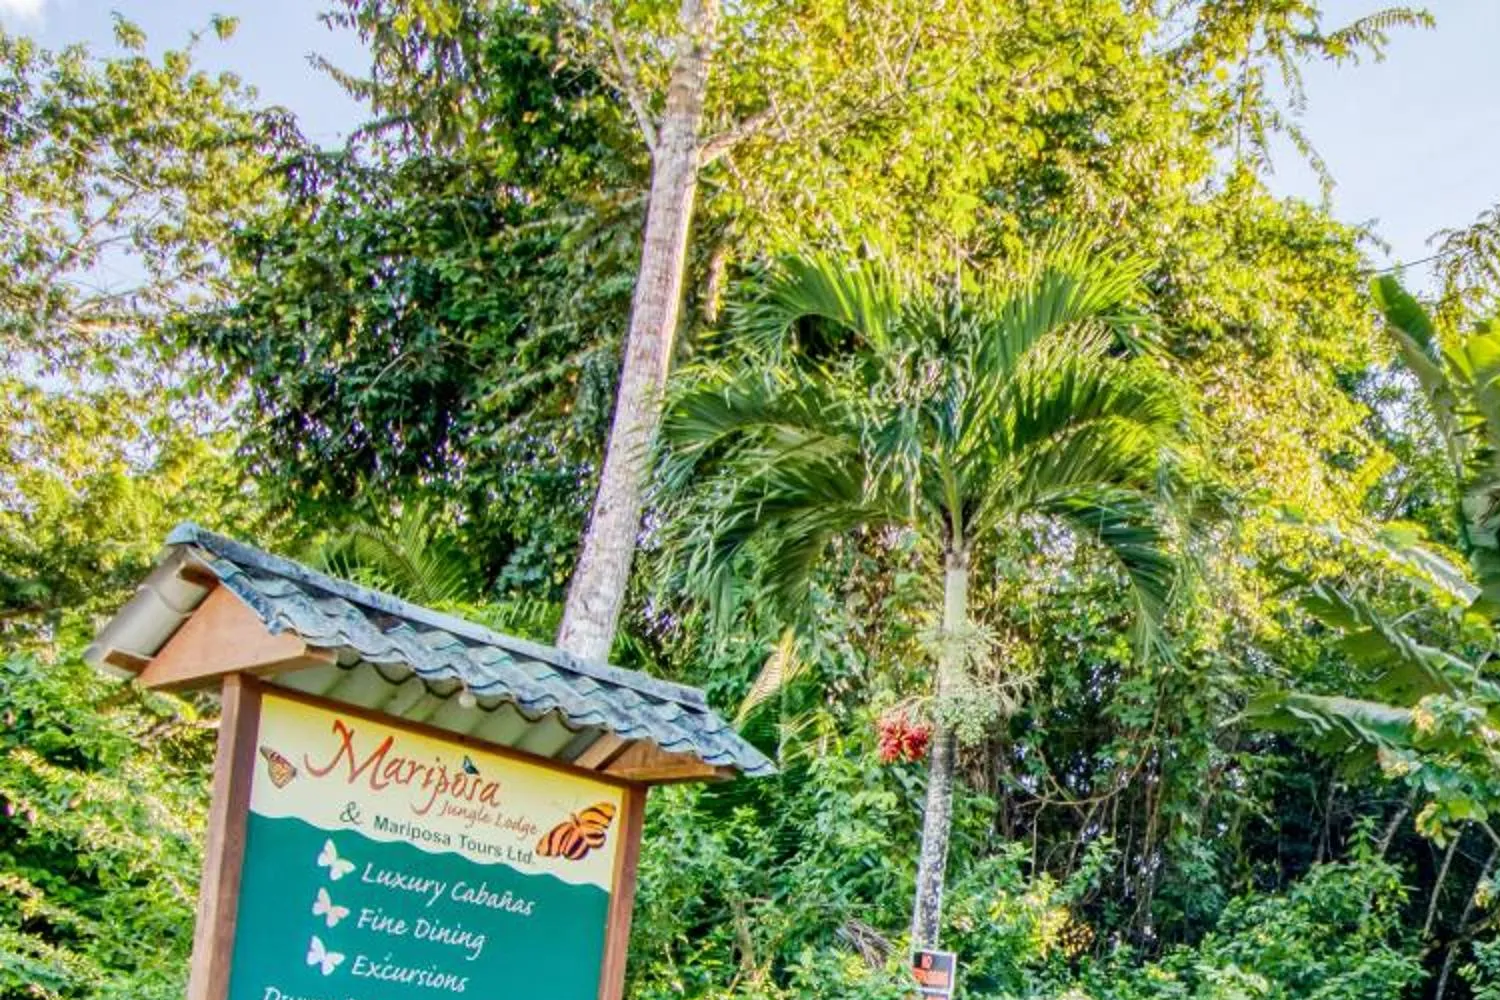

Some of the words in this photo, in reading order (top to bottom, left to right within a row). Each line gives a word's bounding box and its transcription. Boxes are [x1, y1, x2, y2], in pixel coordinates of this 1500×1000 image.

[304, 719, 501, 815] Mariposa
[339, 801, 364, 825] &
[373, 815, 451, 845] Mariposa
[458, 834, 502, 857] Tours
[507, 845, 536, 864] Ltd.
[440, 799, 492, 830] Jungle
[496, 815, 539, 840] Lodge
[361, 862, 447, 907] Luxury
[451, 880, 536, 916] Cabañas
[357, 907, 408, 935] Fine
[413, 918, 487, 961] Dining
[351, 954, 471, 993] Excursions
